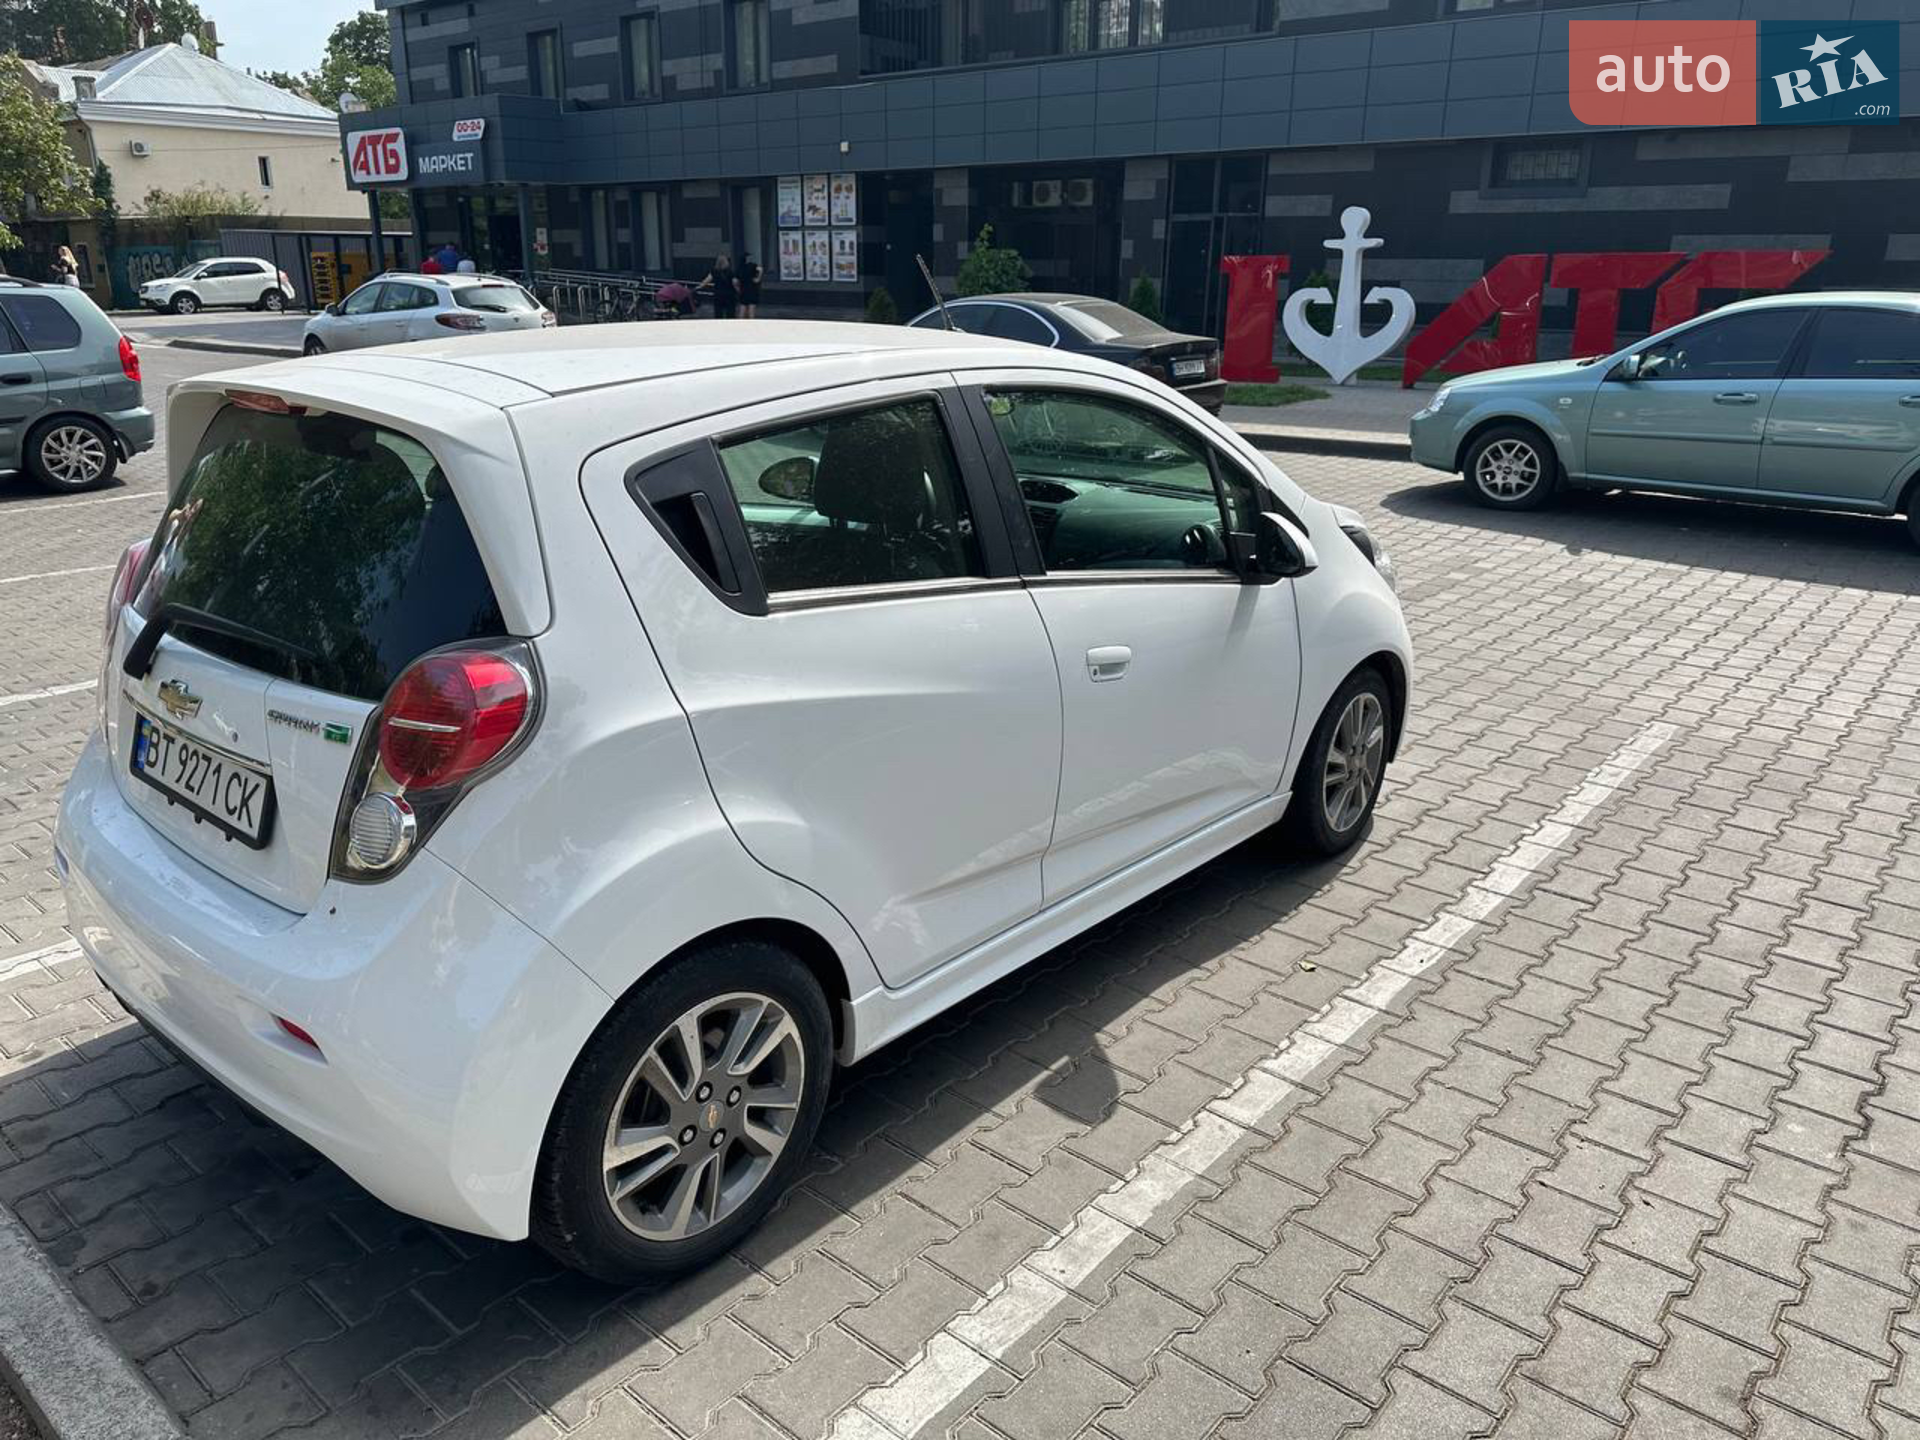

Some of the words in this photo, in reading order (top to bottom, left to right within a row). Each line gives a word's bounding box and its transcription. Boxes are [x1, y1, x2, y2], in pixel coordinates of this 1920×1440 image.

[353, 131, 400, 176] АТБ
[418, 152, 474, 174] МАРКЕТ
[145, 724, 176, 777] BT
[175, 742, 222, 806] 9271
[225, 771, 261, 829] CK
